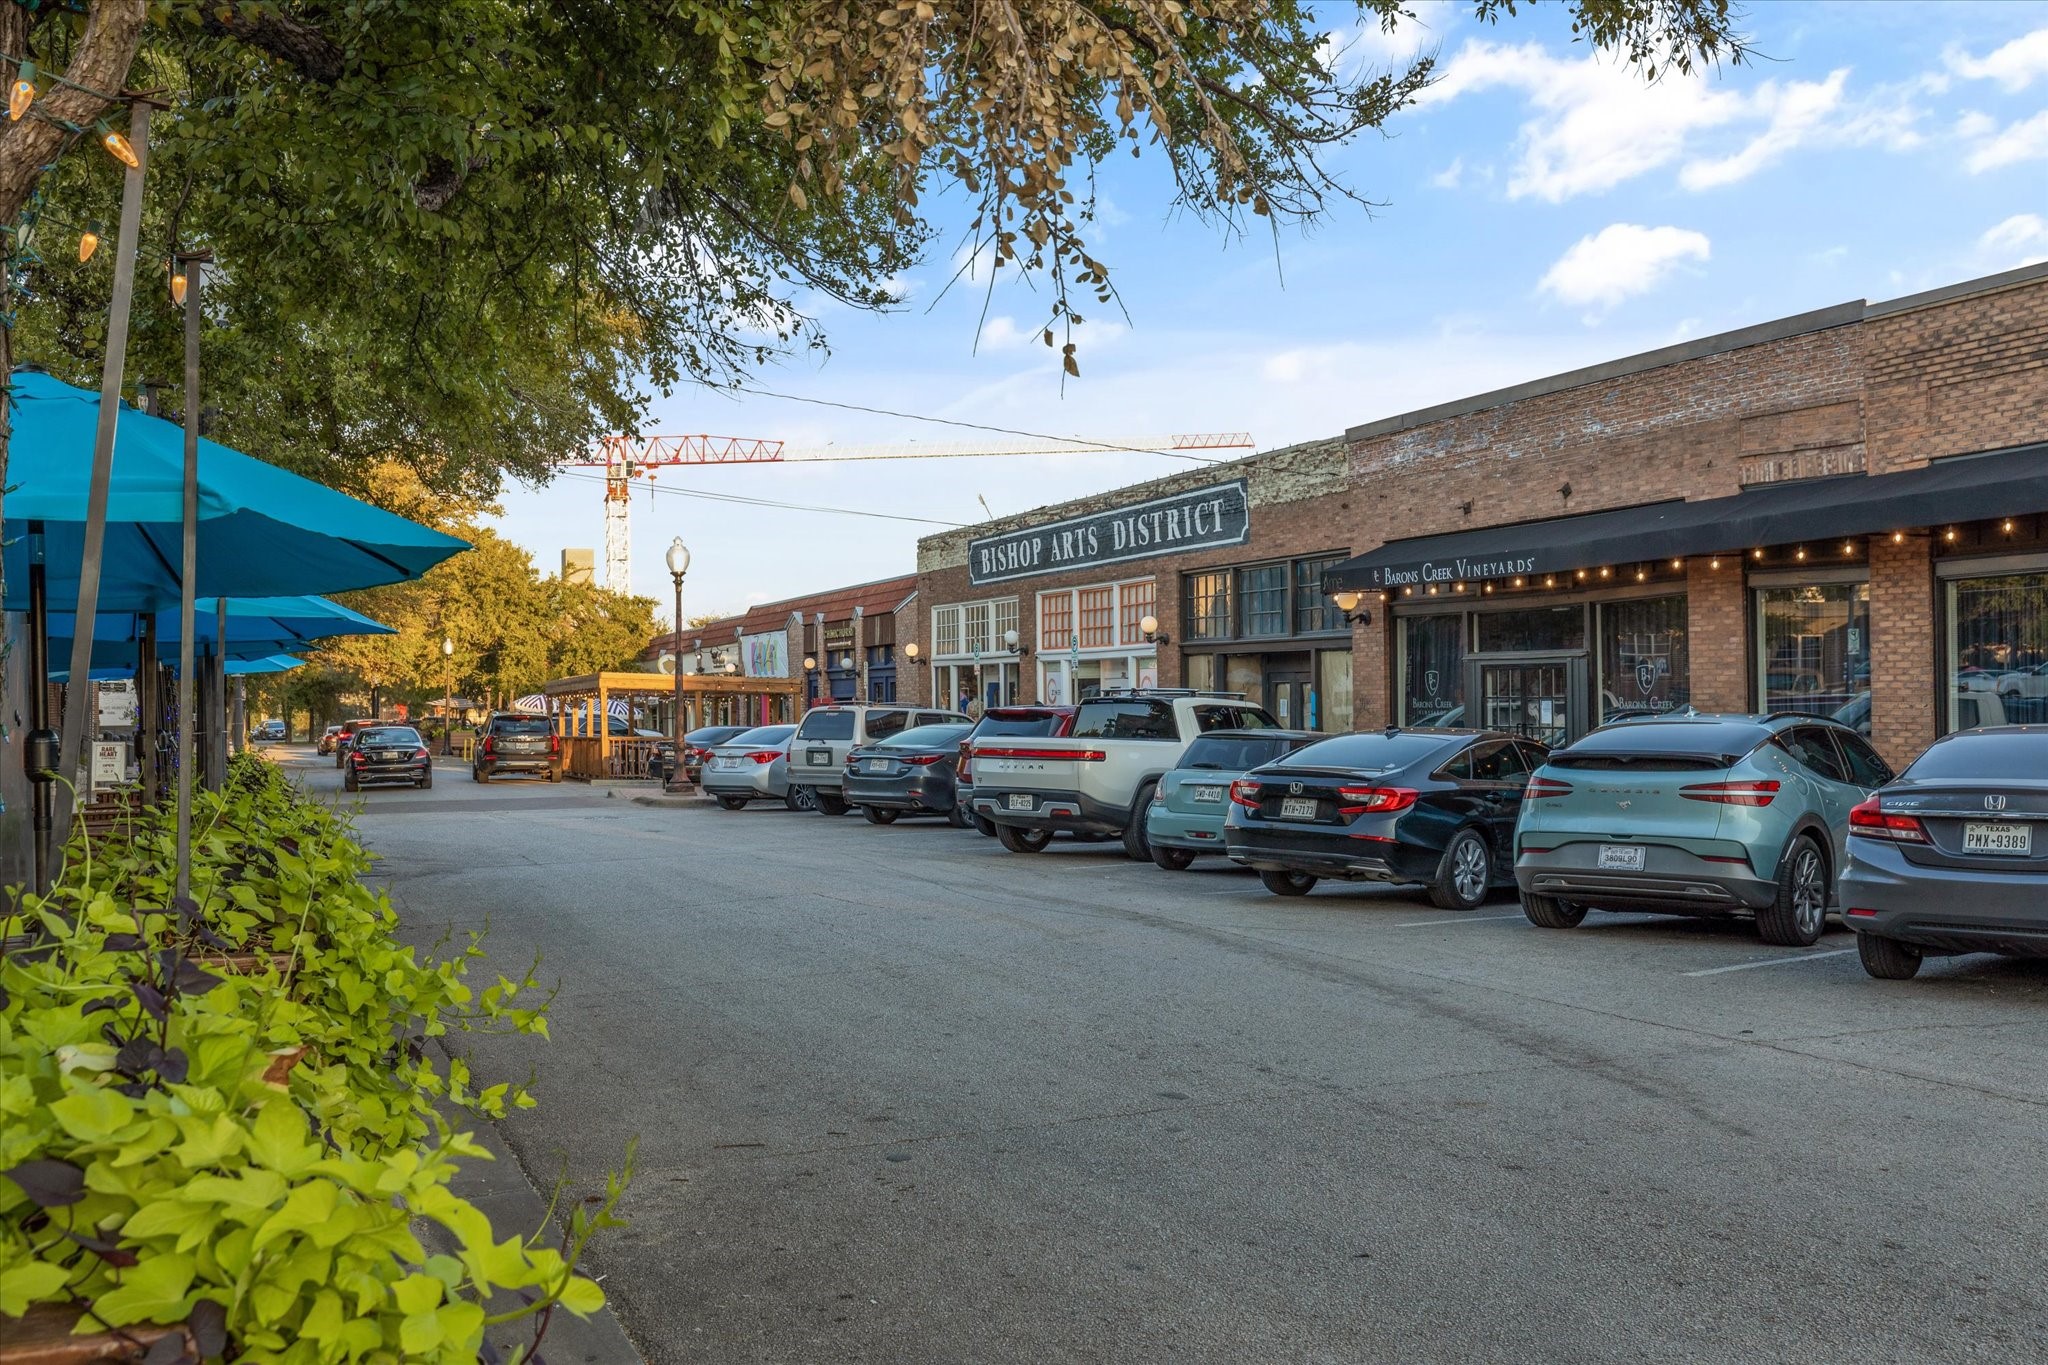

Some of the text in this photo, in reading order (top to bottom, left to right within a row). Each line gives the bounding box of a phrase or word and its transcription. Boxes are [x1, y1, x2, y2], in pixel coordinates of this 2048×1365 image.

[981, 499, 1225, 574] BISHOP ARTS DISTRICT
[1985, 825, 2011, 833] TEXAS
